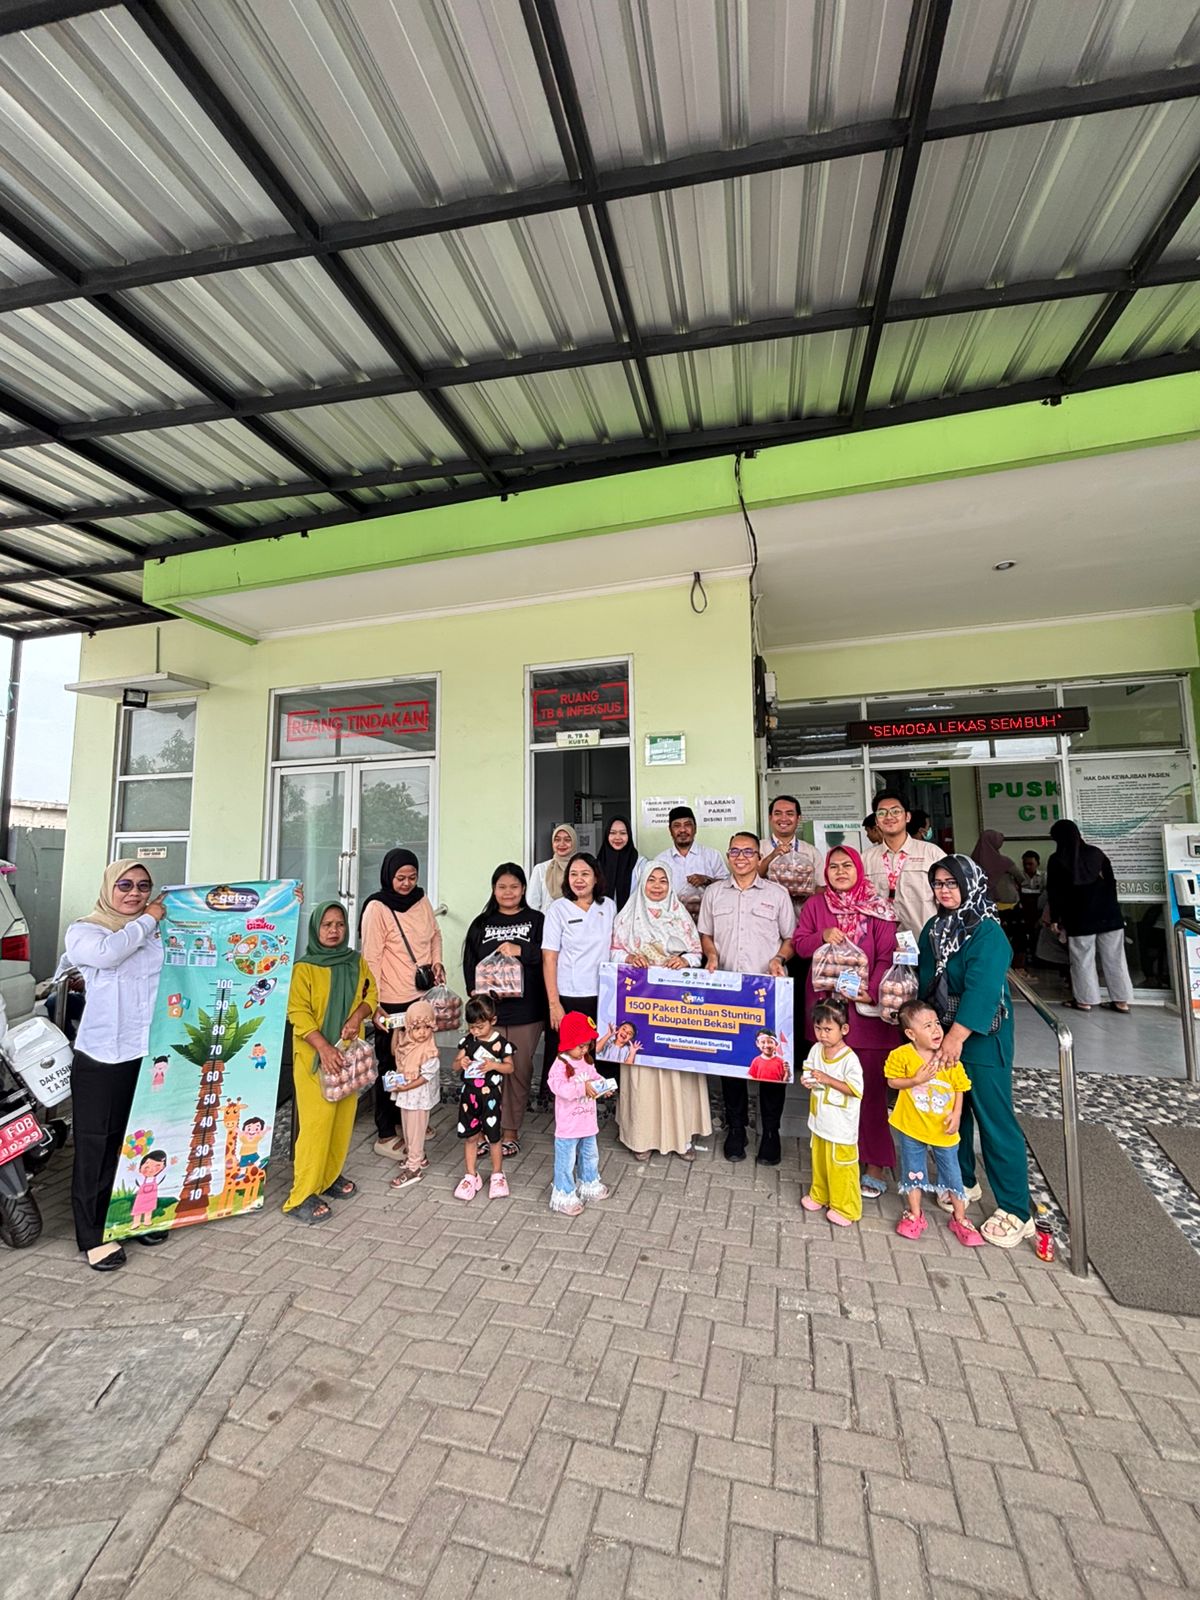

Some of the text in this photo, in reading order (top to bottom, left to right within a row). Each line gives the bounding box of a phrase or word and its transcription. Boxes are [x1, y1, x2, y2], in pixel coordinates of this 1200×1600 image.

[560, 690, 599, 705] RUANG
[541, 702, 621, 719] TB & INFEKSIUS
[292, 710, 426, 735] RUANG TINDAKAN
[939, 719, 987, 734] LEKAS
[485, 926, 531, 938] BASECAMP
[216, 979, 233, 989] 100
[215, 1000, 229, 1010] 90
[628, 1000, 761, 1022] 1500 Paket Bantuan Stunting
[652, 1013, 736, 1030] Kabupaten Bekasi
[212, 1025, 226, 1035] 80
[656, 1035, 677, 1045] Gerakan
[708, 1041, 731, 1050] Stunting
[210, 1045, 222, 1055] 70
[39, 1073, 56, 1087] DAK
[206, 1071, 219, 1082] 60
[54, 1083, 61, 1091] A
[203, 1093, 216, 1105] 50
[200, 1116, 213, 1128] 40
[195, 1144, 209, 1157] 30
[192, 1166, 206, 1179] 20
[190, 1188, 203, 1201] 10
